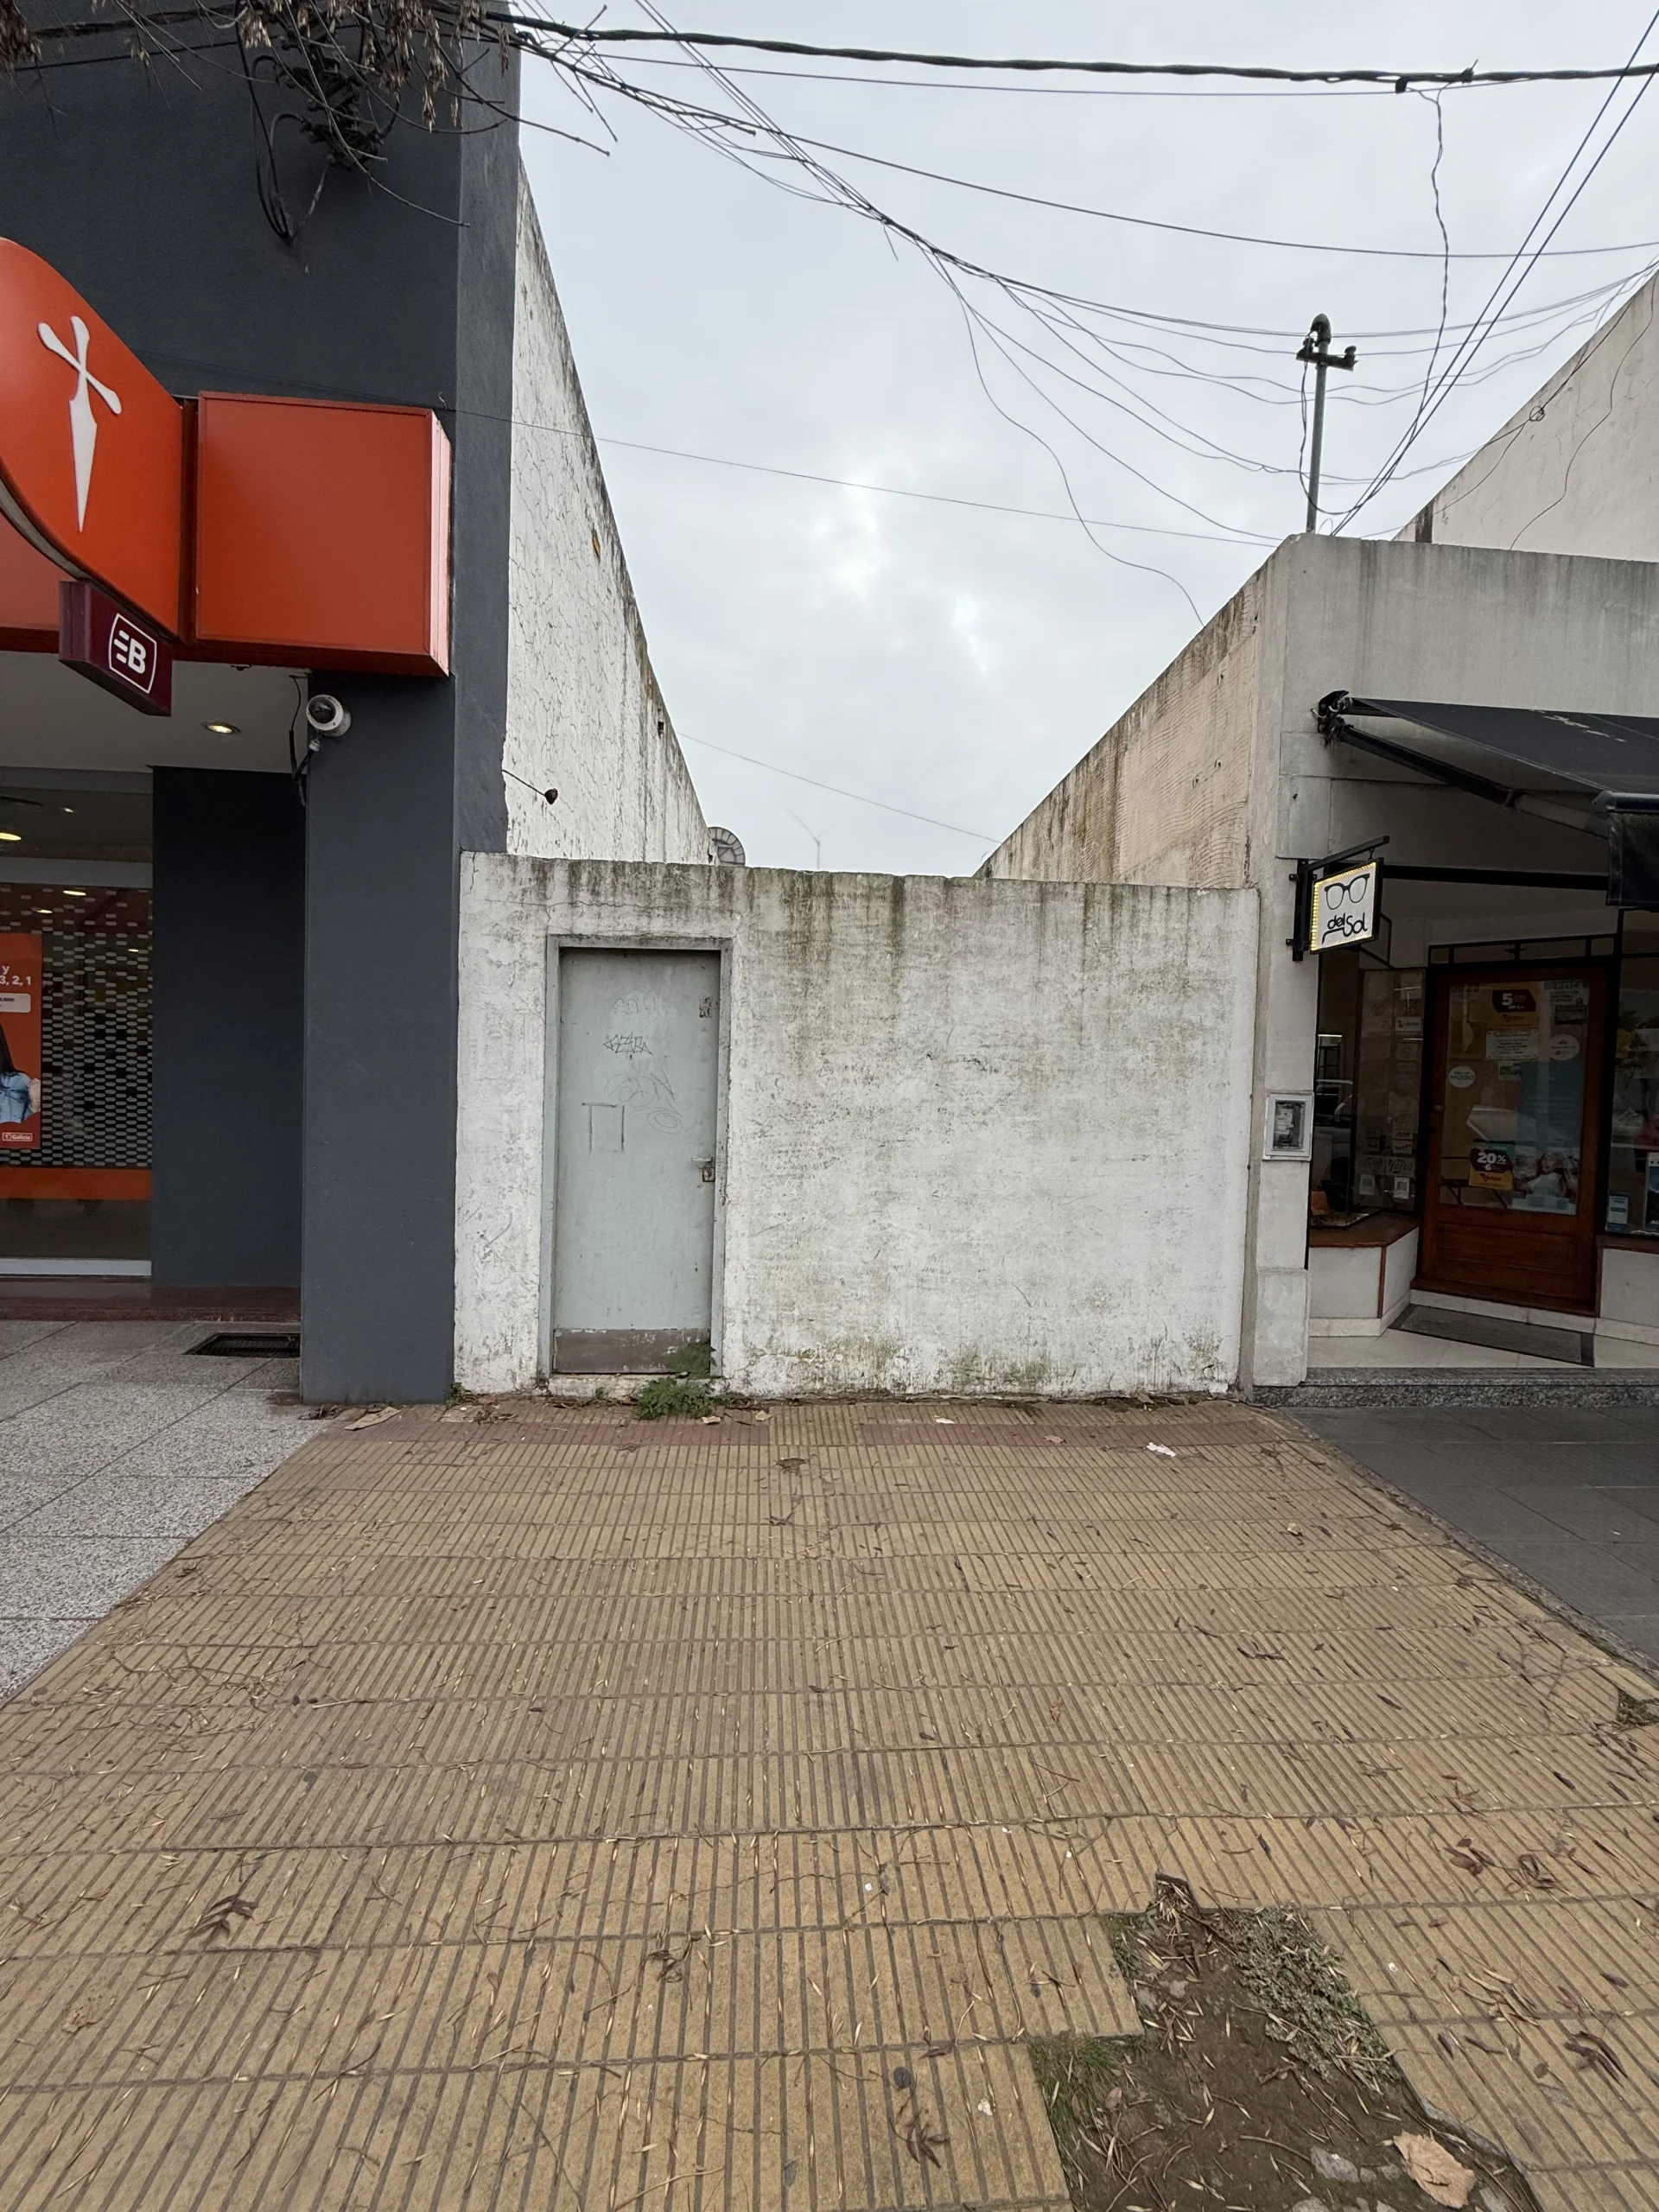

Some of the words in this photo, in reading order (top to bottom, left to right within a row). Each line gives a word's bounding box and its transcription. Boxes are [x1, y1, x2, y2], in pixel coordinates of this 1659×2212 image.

[2, 965, 10, 975] y
[26, 976, 31, 986] 1
[1501, 993, 1513, 1006] 5
[1477, 1152, 1507, 1164] 20%
